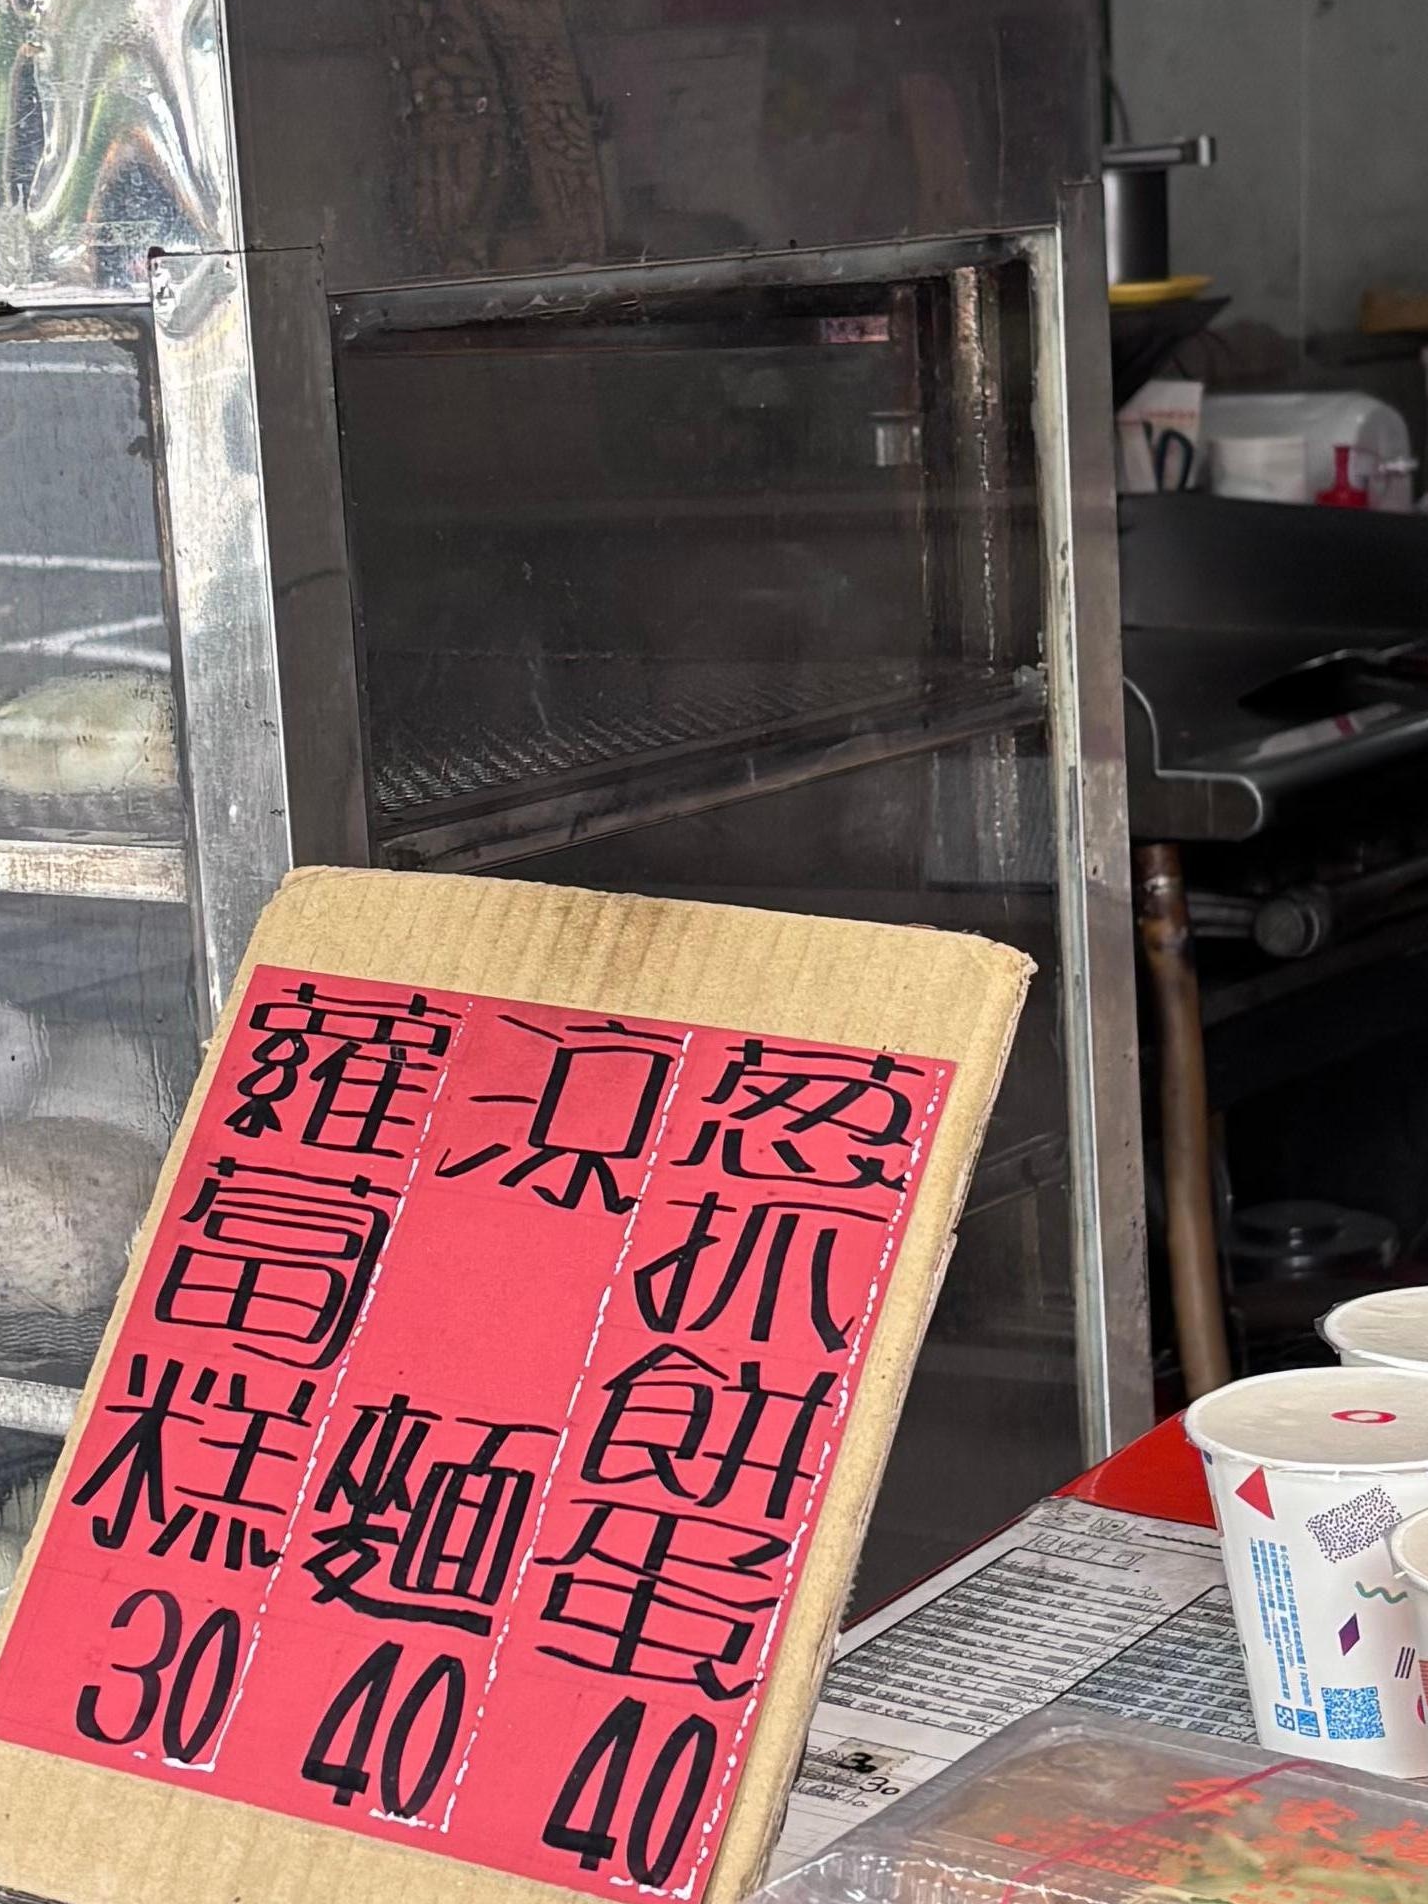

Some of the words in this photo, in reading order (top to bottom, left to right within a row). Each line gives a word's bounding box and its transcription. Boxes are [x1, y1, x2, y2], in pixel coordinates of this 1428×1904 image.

[70, 981, 461, 1572] 蘿蔔糕
[299, 1012, 677, 1637] 涼麵
[76, 1587, 241, 1765] 30
[299, 1641, 466, 1821] 40
[544, 1695, 718, 1889] 40
